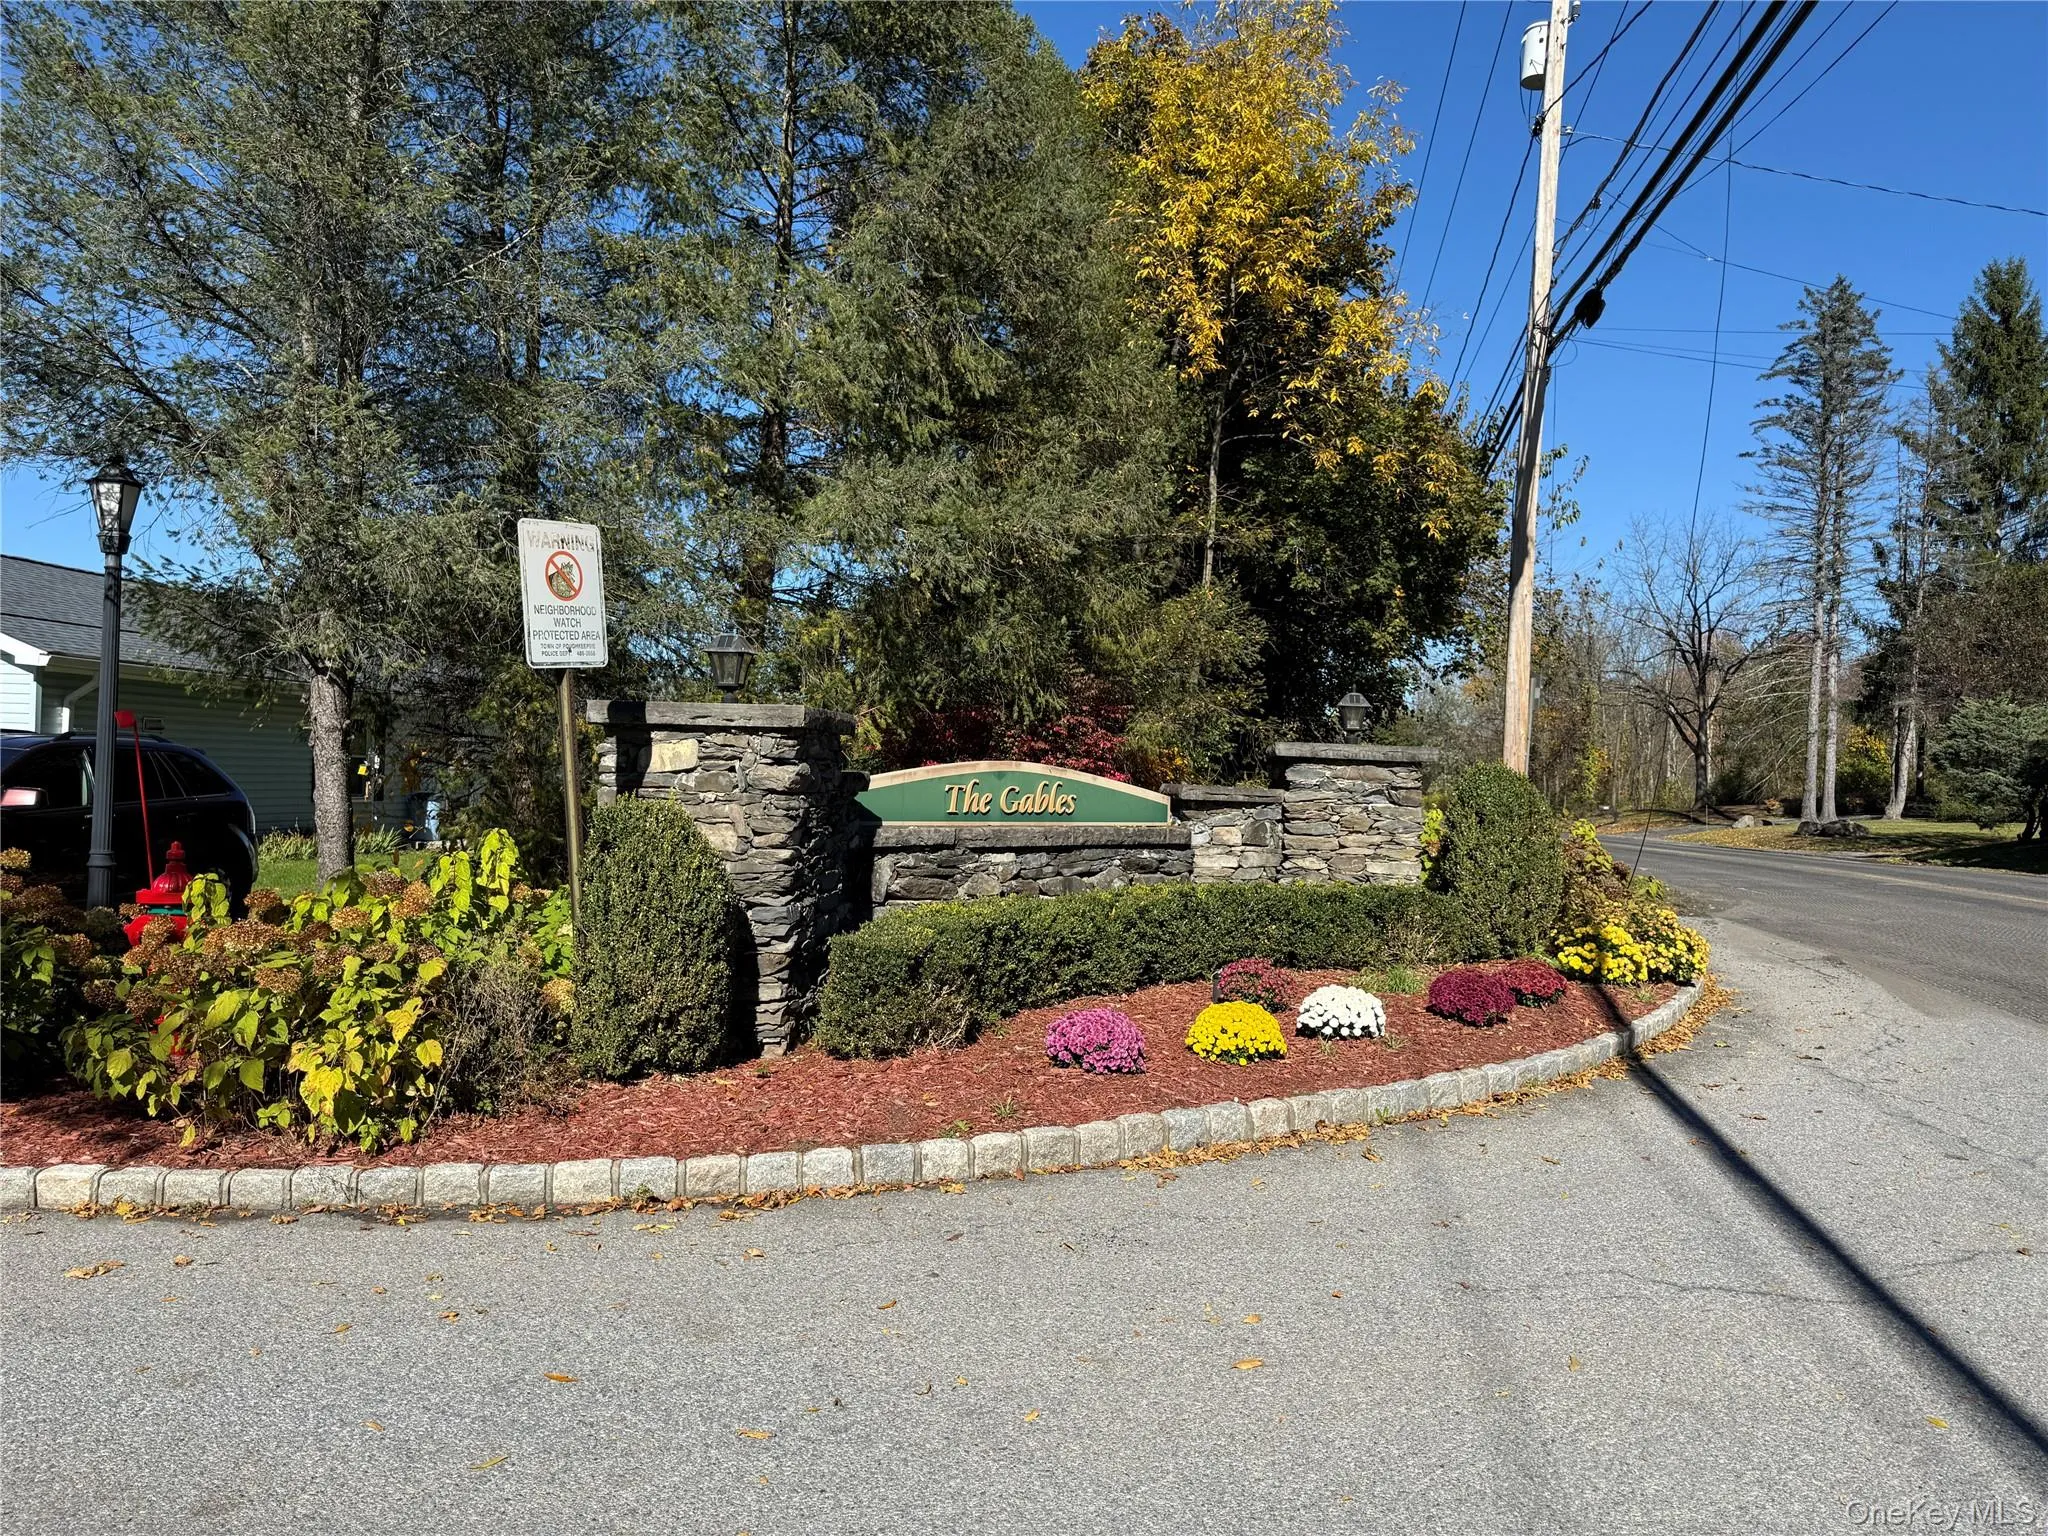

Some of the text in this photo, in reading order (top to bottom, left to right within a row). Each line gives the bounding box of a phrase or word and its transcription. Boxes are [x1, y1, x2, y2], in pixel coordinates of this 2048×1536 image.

[526, 530, 595, 552] WARNING
[533, 604, 597, 616] NEIGHBORHOOD
[553, 617, 582, 628] WATCH
[532, 630, 601, 641] PROTECTED AREA
[944, 778, 1077, 816] The Gables
